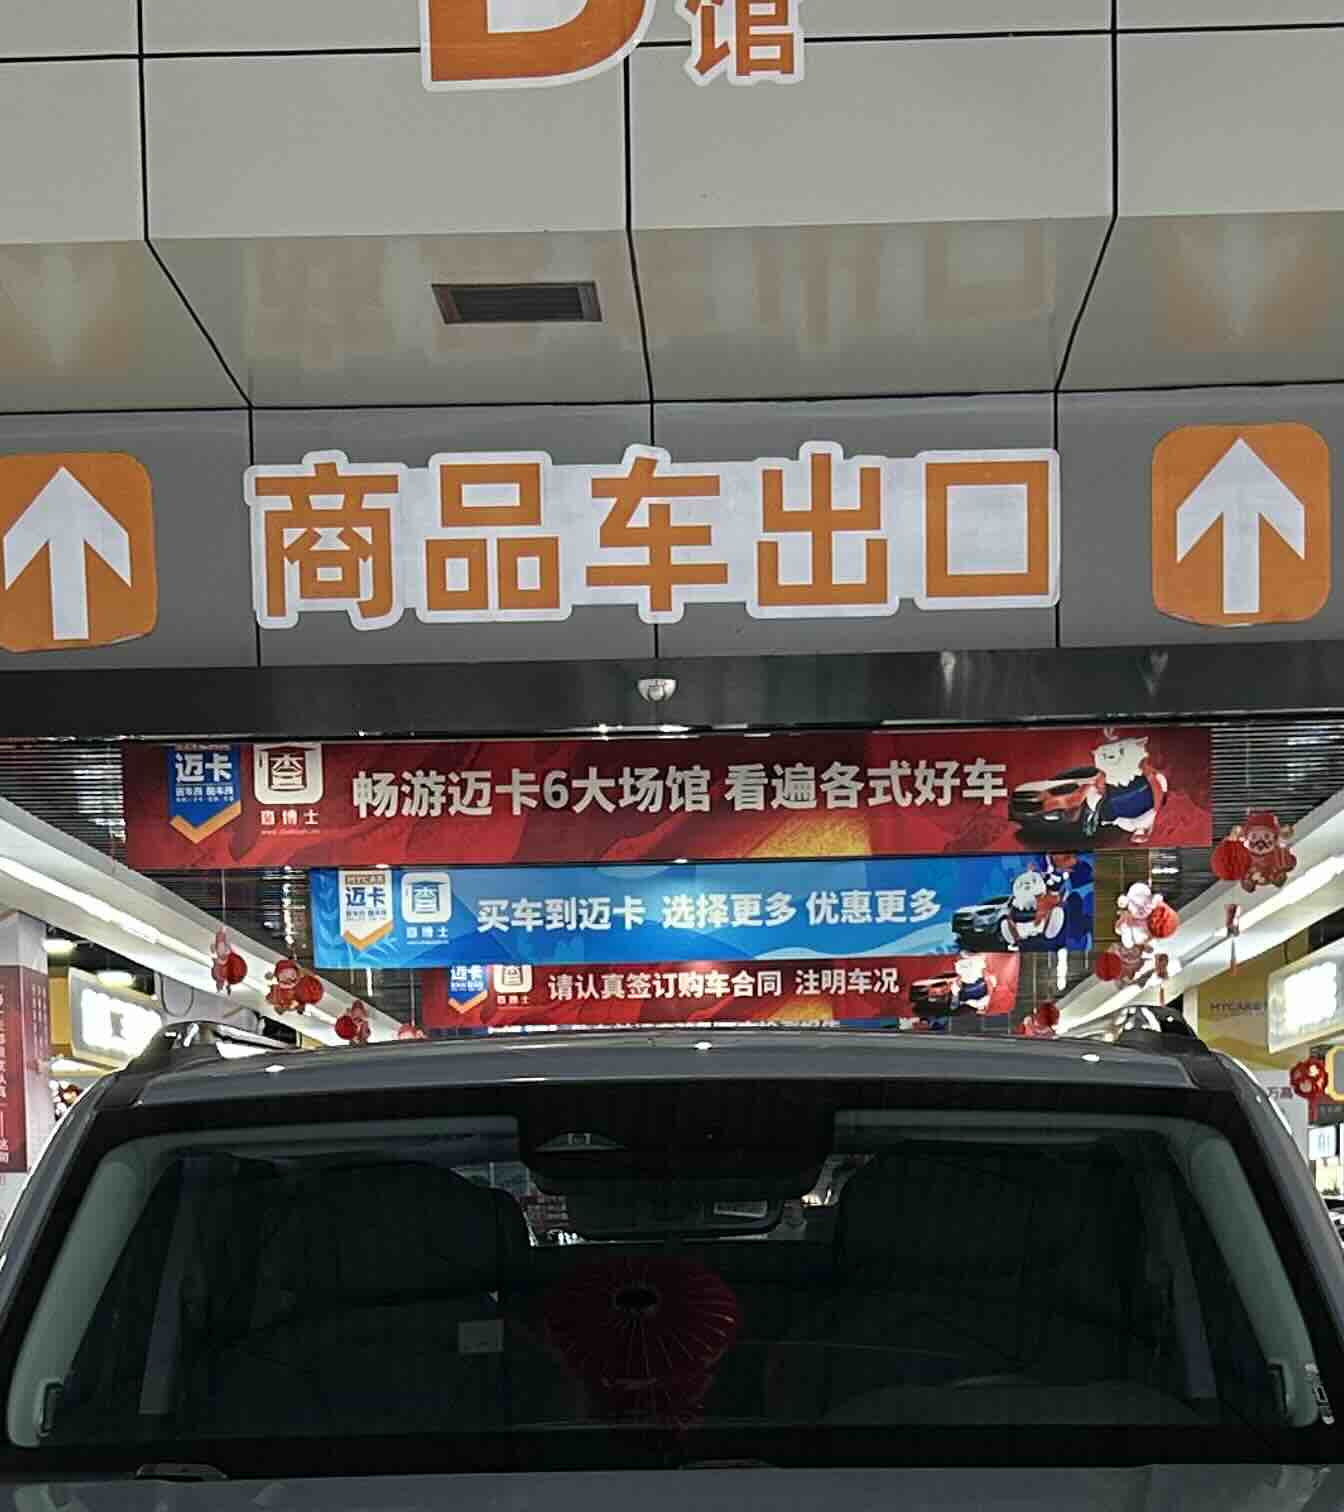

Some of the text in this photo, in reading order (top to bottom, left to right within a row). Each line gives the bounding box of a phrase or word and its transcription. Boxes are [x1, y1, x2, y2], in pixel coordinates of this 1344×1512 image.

[250, 447, 1058, 624] 商品车出口
[176, 753, 232, 783] 迈卡
[352, 758, 1008, 819] 畅游迈卡6大场馆 看遍各式好车
[345, 887, 386, 907] 迈卡
[476, 888, 942, 933] 买车到迈卡 选择更多 优惠更多
[547, 966, 900, 1001] 请认真签订购车合同 注明车况
